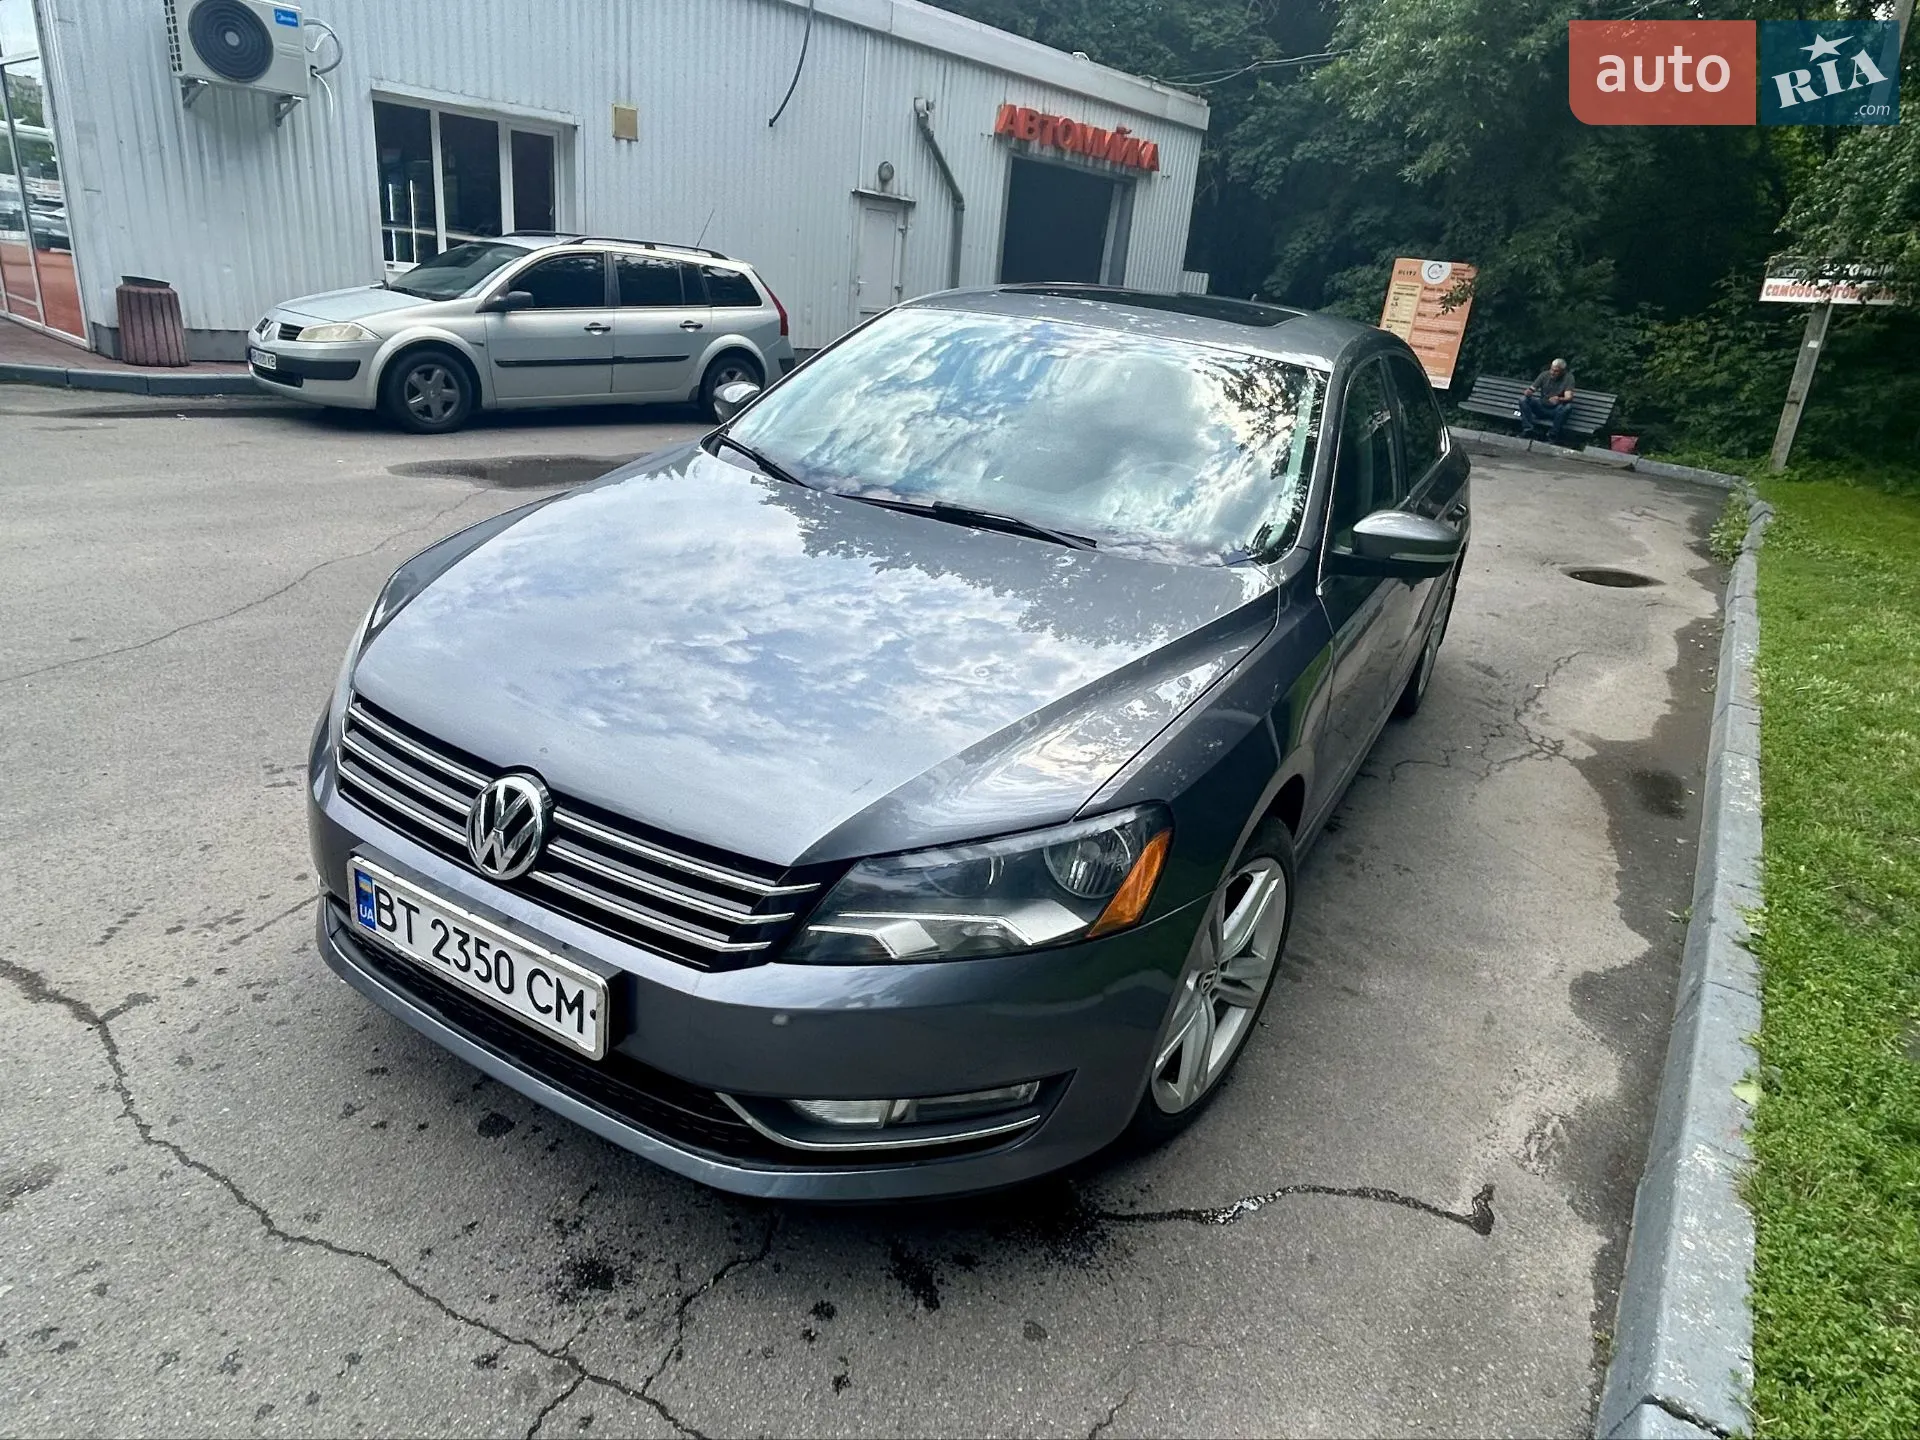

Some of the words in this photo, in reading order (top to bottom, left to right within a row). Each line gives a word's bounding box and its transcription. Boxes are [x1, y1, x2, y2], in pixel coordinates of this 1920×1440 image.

[359, 903, 375, 923] UA
[374, 884, 420, 945] BT
[430, 918, 515, 995] 2350
[526, 967, 585, 1035] CM
